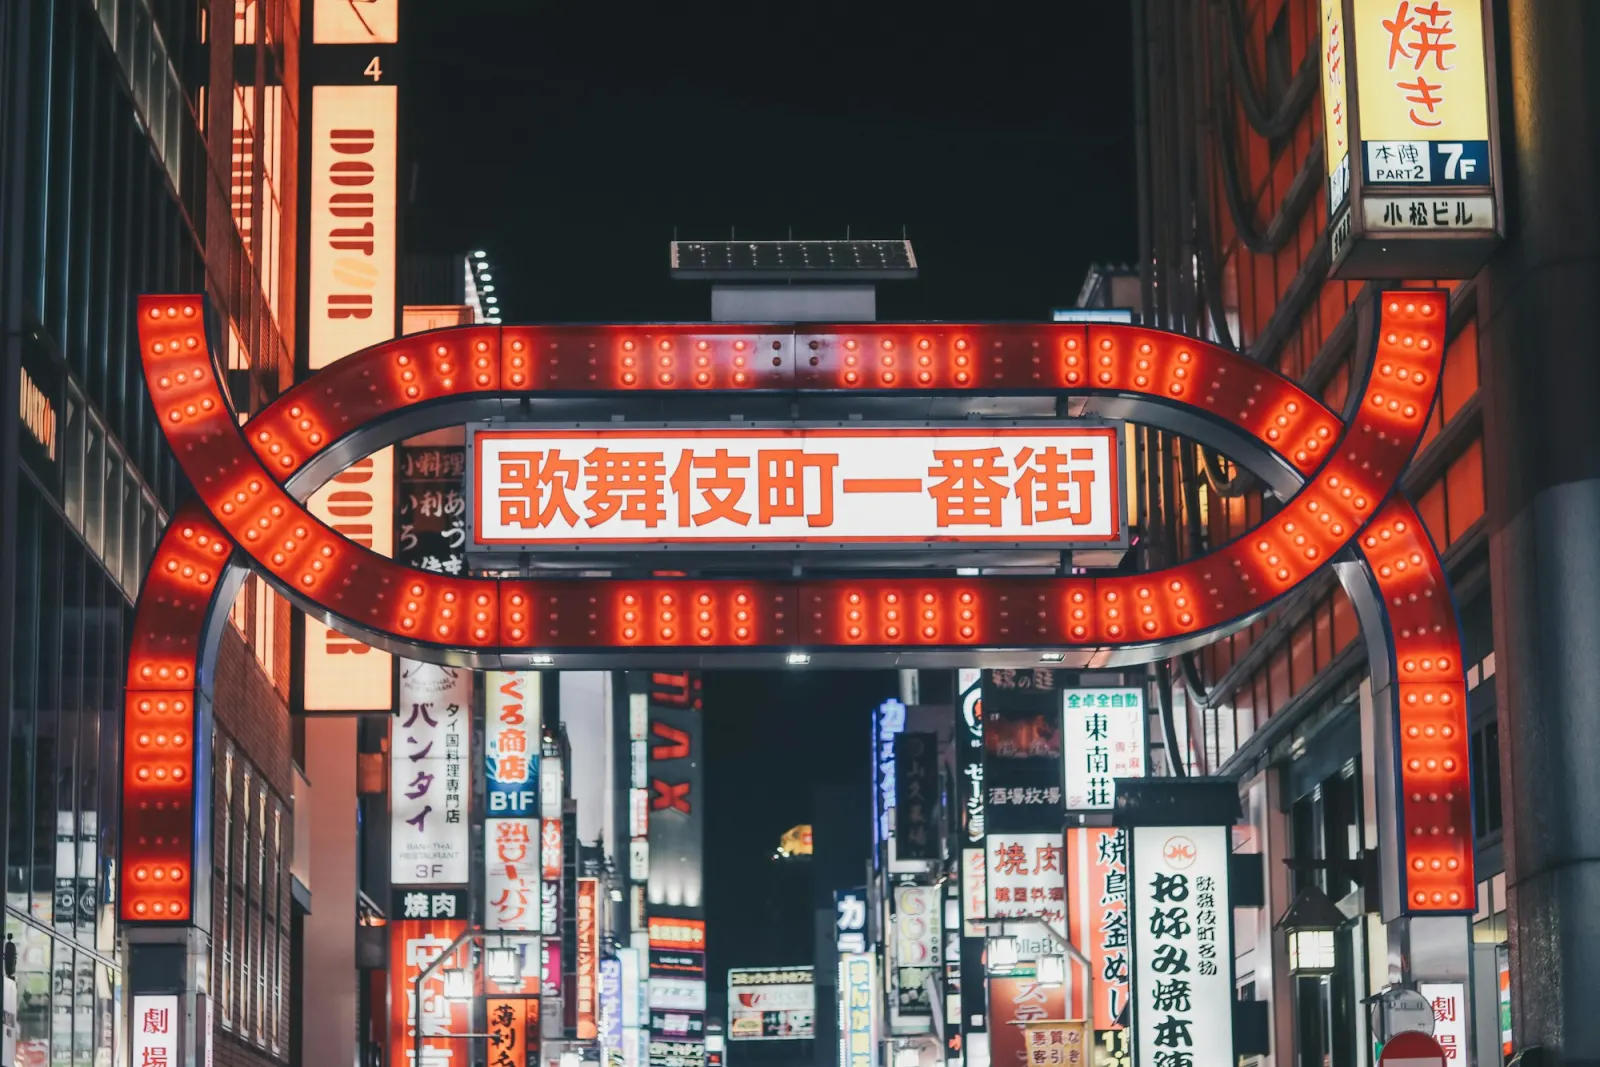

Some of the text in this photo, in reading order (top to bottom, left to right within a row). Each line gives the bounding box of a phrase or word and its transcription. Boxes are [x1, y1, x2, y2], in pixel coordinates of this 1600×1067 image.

[363, 56, 383, 82] 4
[1382, 1, 1457, 127] 焼き
[1375, 144, 1419, 164] 本陣
[1437, 143, 1476, 180] 7F
[1376, 165, 1425, 180] PART2
[327, 129, 375, 319] DOUTOR
[1383, 201, 1473, 226] 小松ビル
[498, 446, 1096, 528] 歌舞伎町一番街
[1067, 693, 1138, 708] 全卓全自動
[498, 671, 526, 780] ぐろ商店
[1128, 712, 1140, 778] リーチ麻
[402, 703, 438, 832] バンタイ
[446, 703, 460, 824] タイ国料理専門店
[1085, 713, 1110, 806] 東南荘
[490, 791, 535, 811] B1F
[989, 788, 1061, 805] 酒場牧場
[399, 851, 459, 860] RESTAURANT
[994, 842, 1064, 876] 焼肉
[415, 864, 443, 878] 3F
[404, 893, 456, 918] 焼肉
[1033, 1031, 1080, 1046] 悪質な
[1033, 1048, 1080, 1064] 客引き
